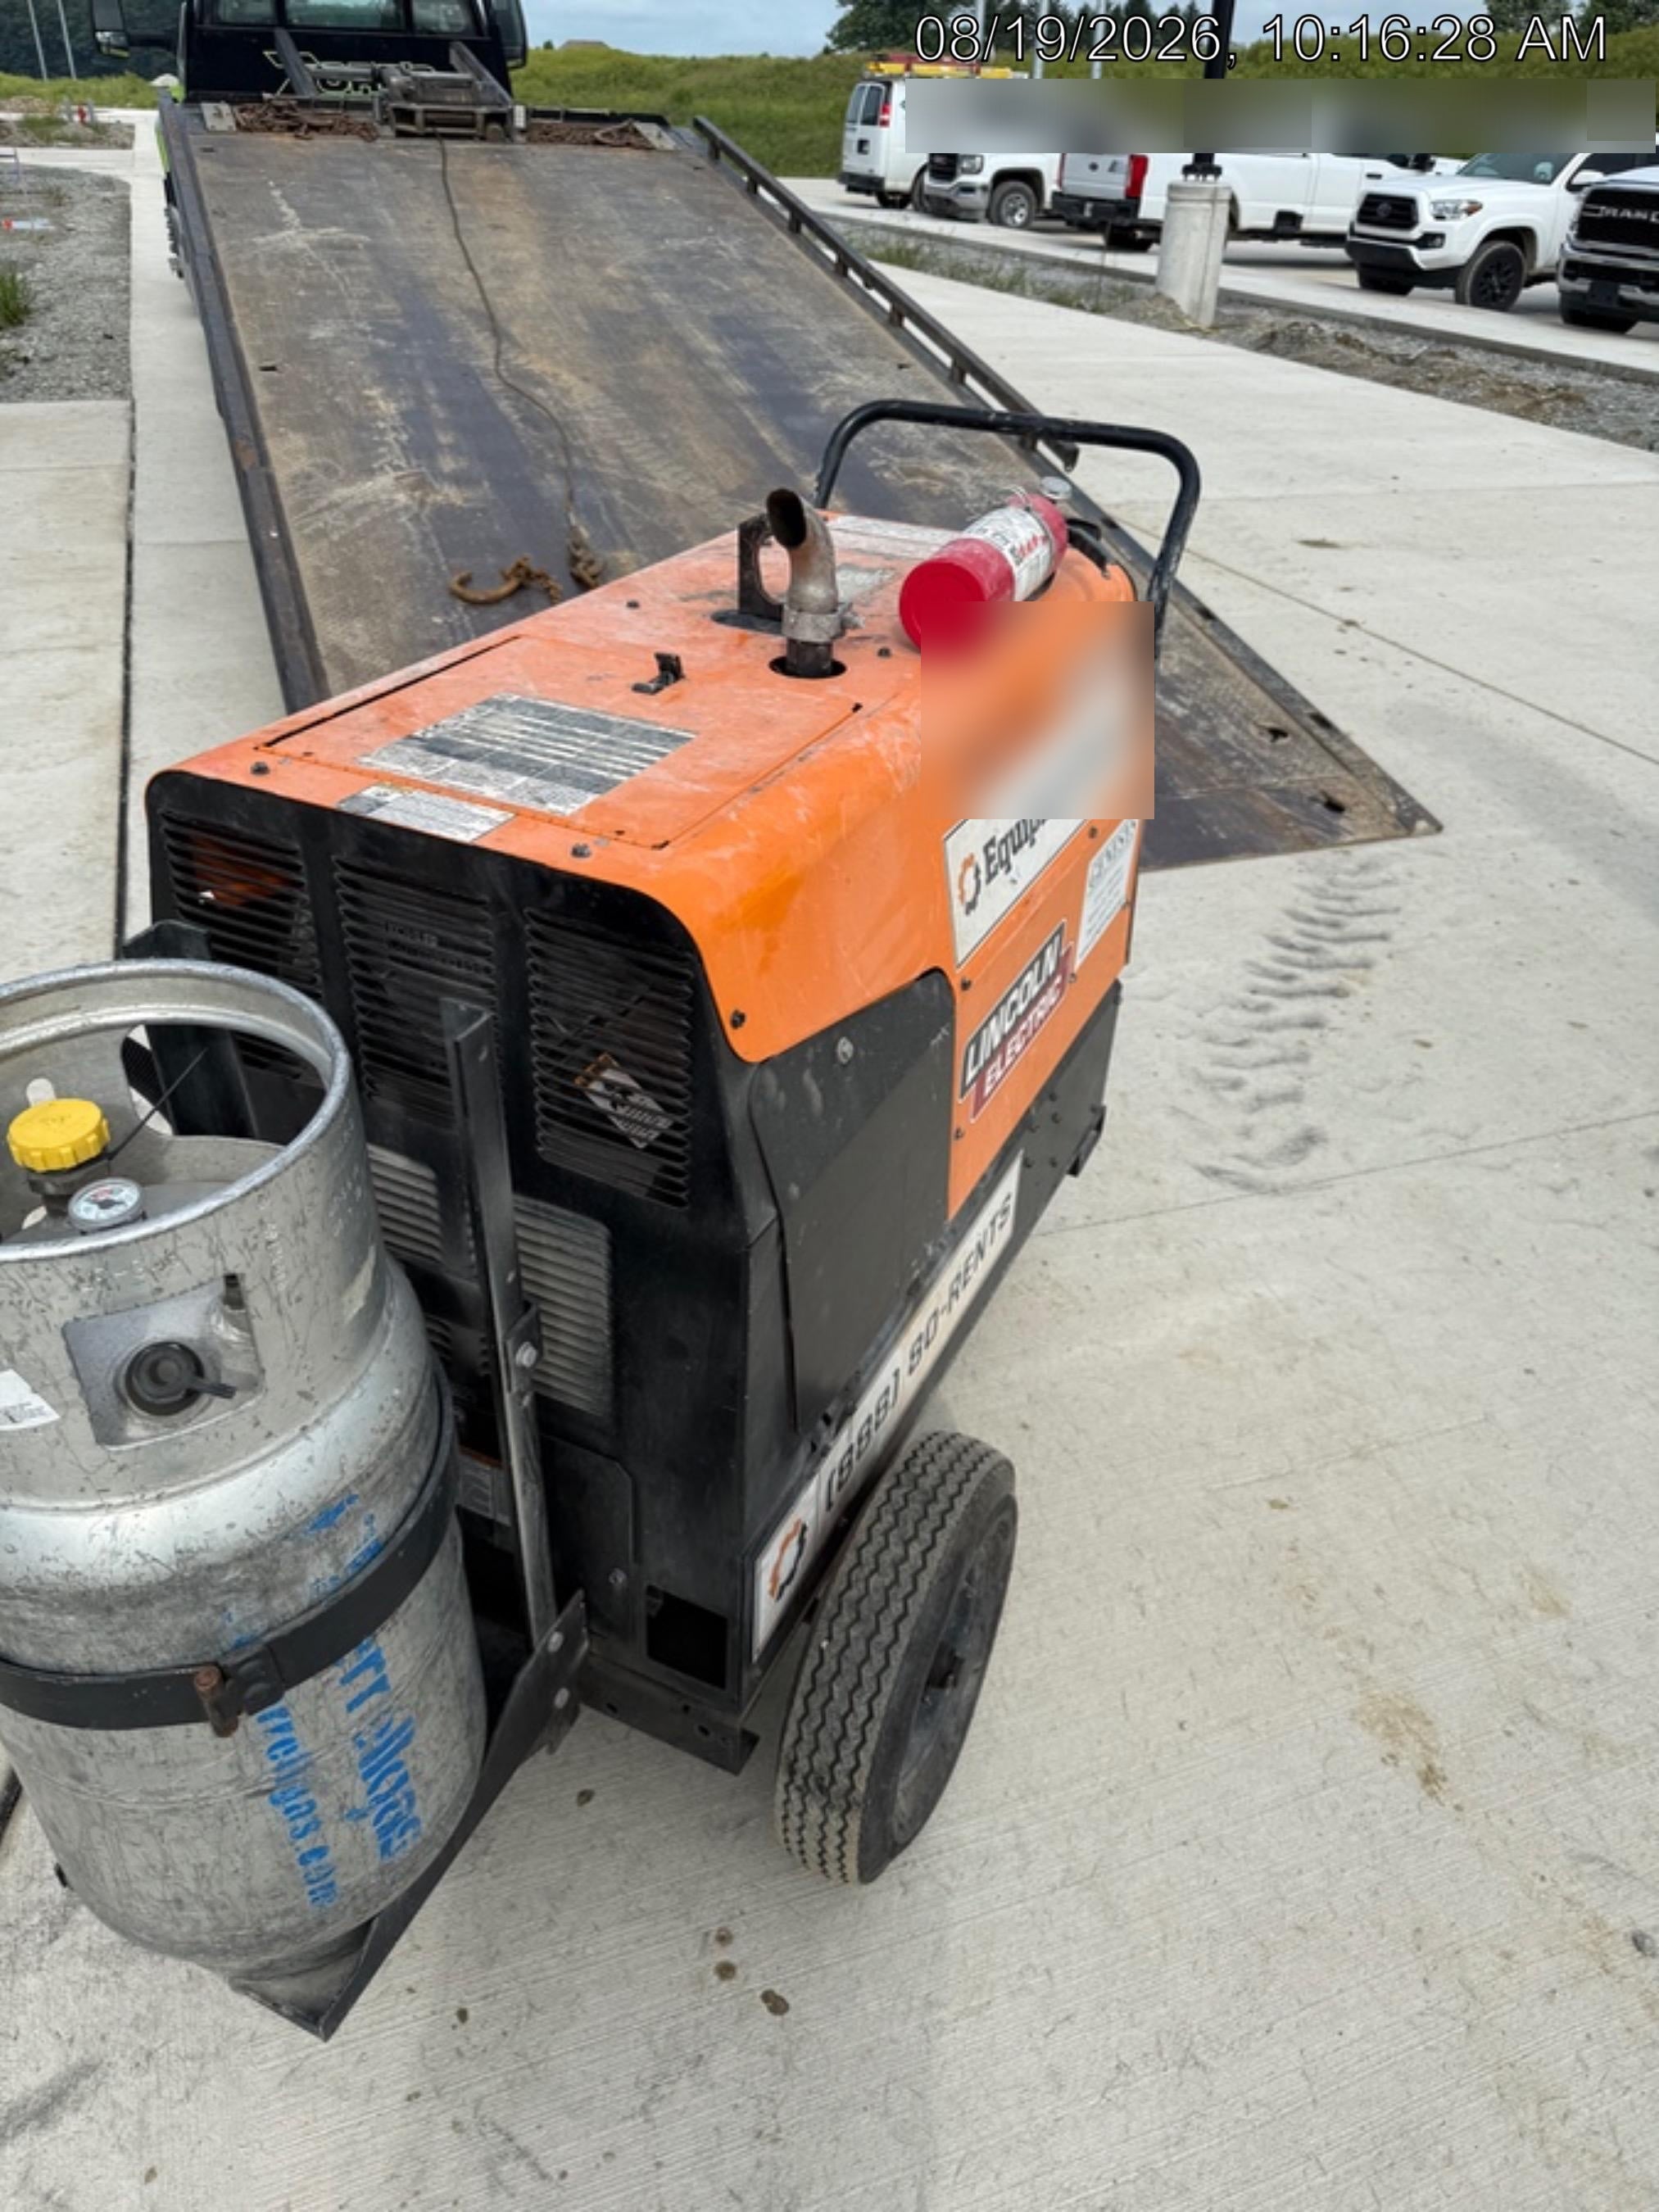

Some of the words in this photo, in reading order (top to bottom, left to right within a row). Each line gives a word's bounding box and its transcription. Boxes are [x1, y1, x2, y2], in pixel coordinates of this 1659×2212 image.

[982, 819, 1048, 885] Equip
[964, 933, 1063, 1087] LINCOLN
[983, 976, 1063, 1096] ELECTRIC
